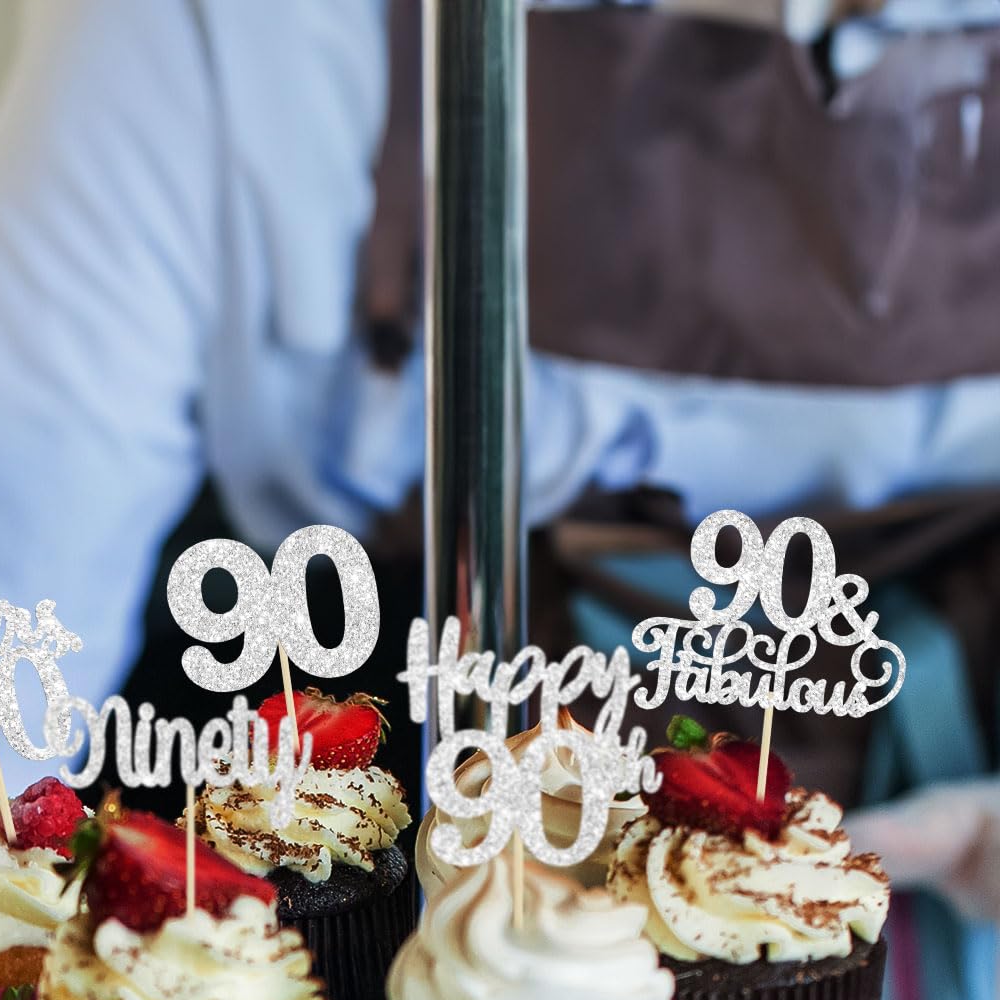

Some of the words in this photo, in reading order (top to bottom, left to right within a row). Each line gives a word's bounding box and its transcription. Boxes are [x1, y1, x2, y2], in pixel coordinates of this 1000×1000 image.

[167, 524, 381, 692] 90
[632, 616, 906, 718] Fabulous
[397, 615, 641, 741] Happy
[45, 695, 313, 829] Ninety
